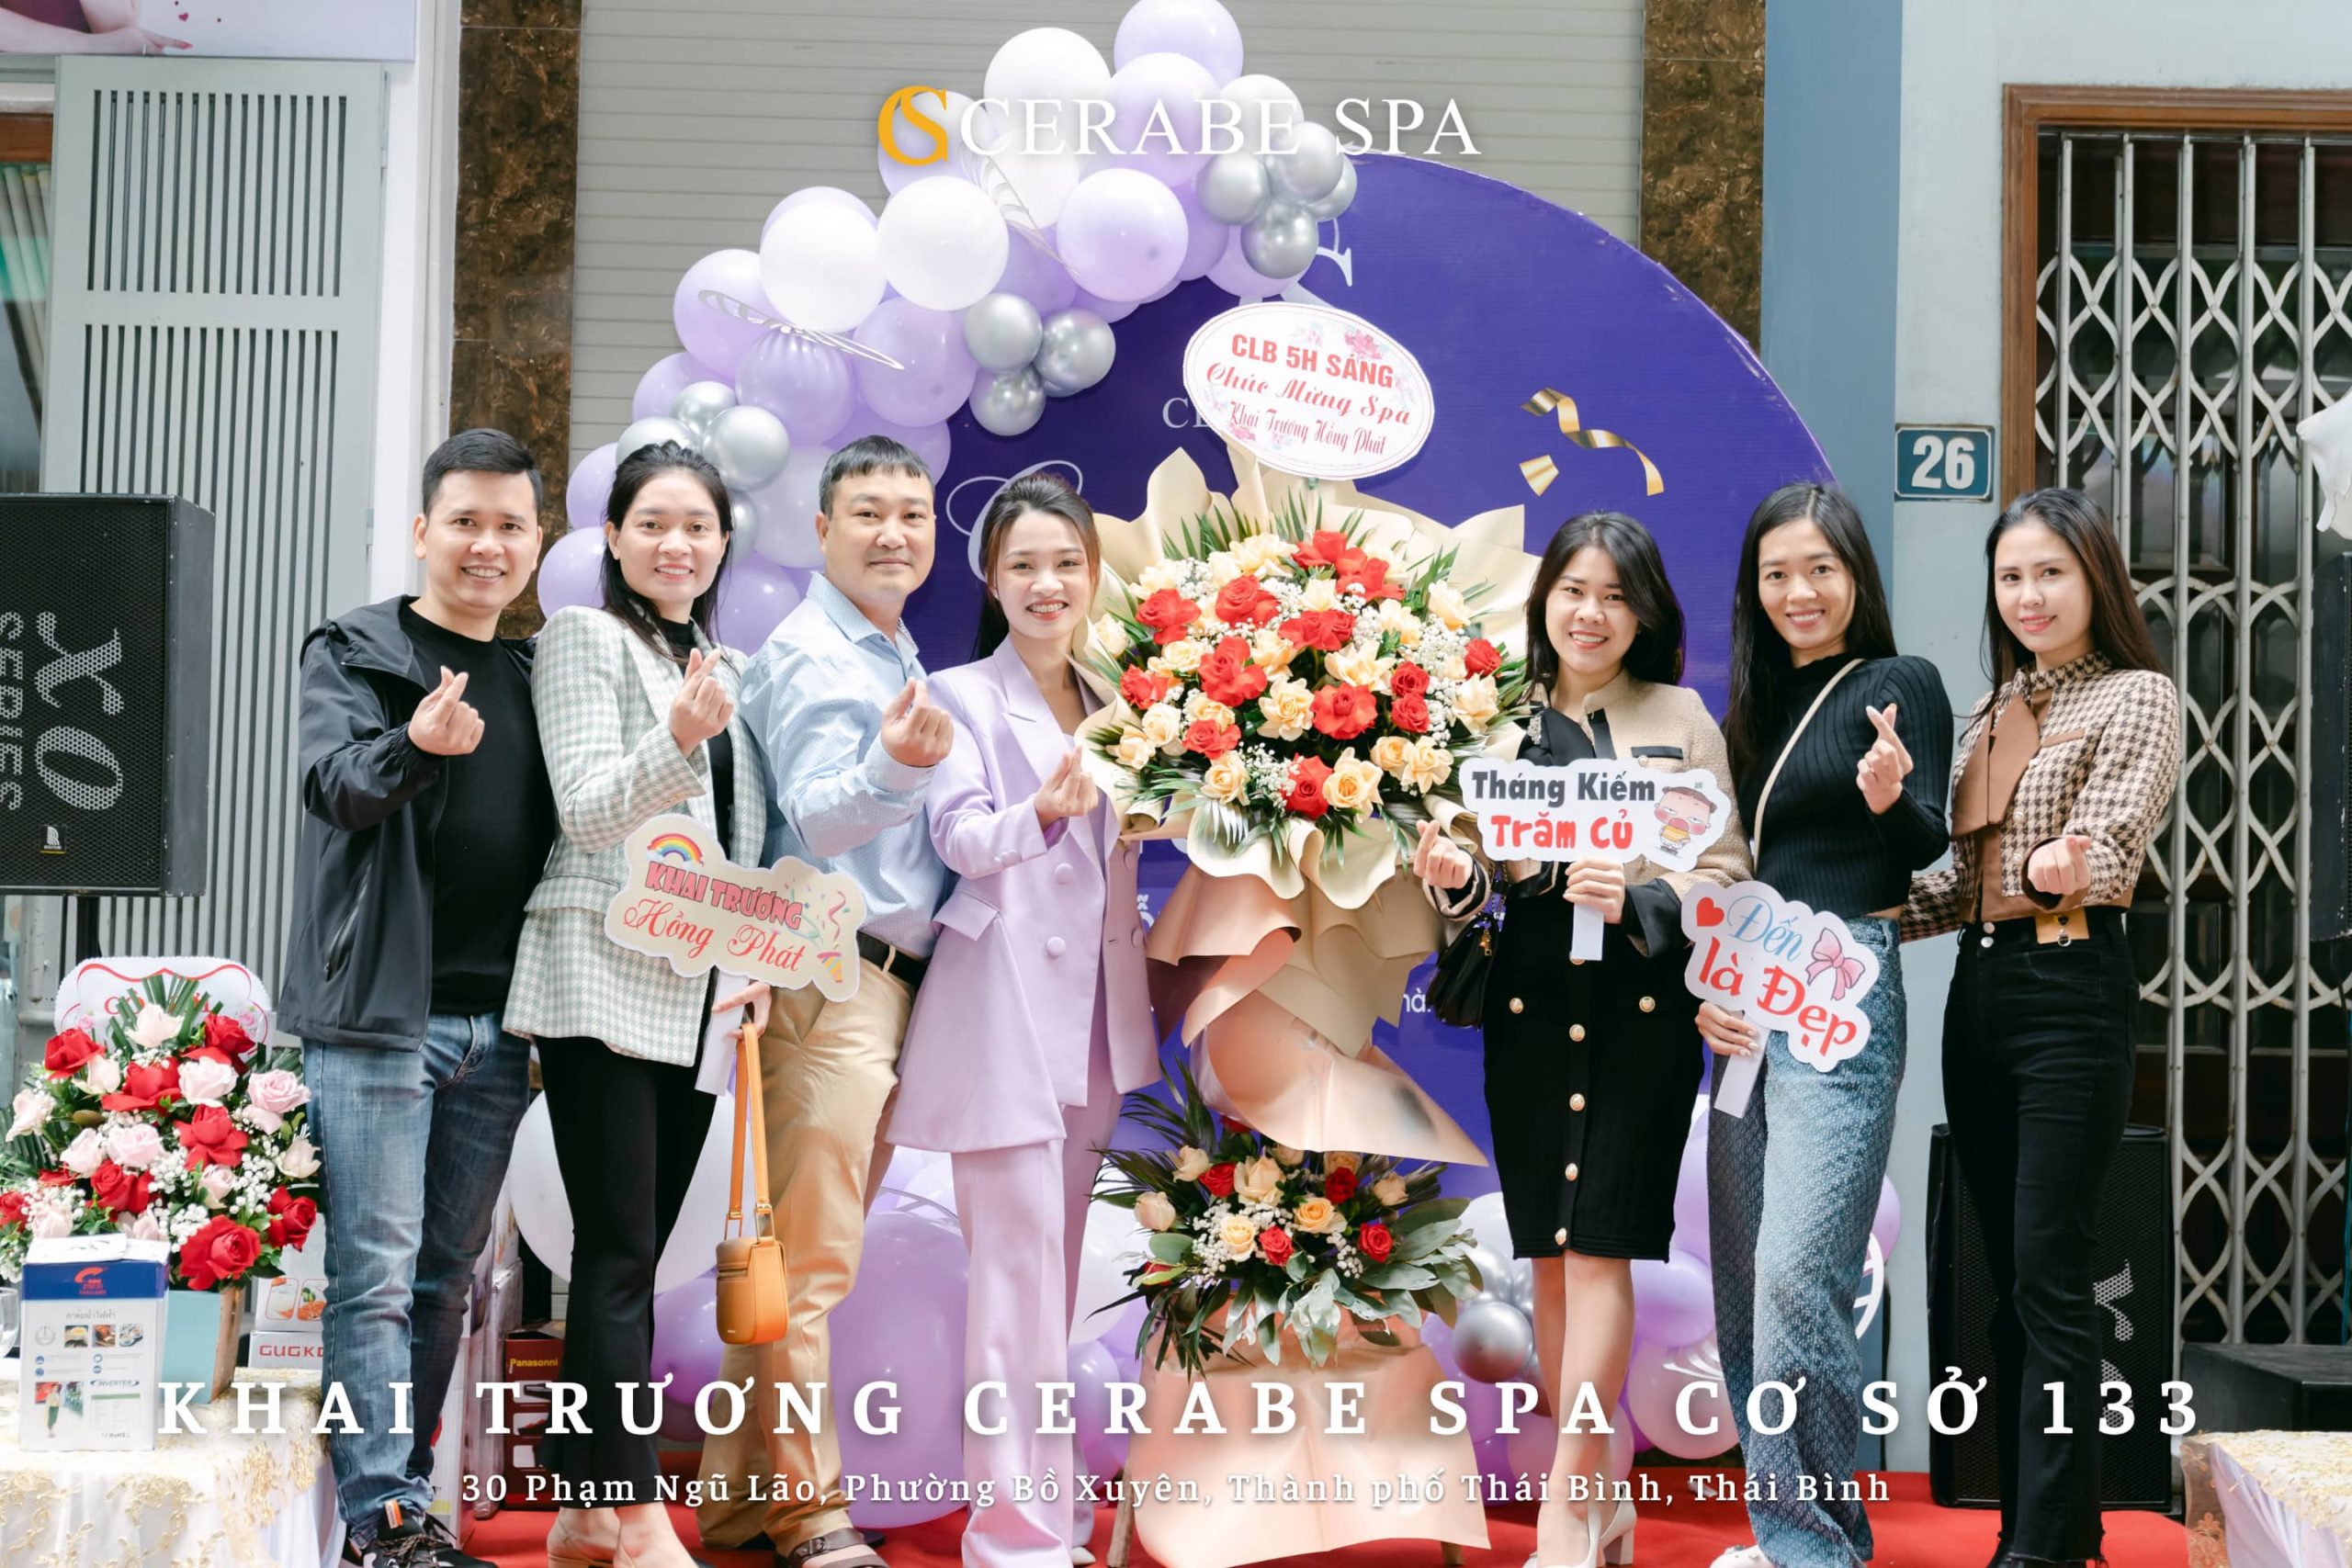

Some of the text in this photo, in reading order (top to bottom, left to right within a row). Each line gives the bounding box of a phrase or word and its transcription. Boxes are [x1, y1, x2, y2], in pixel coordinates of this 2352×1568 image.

[1231, 333, 1394, 389] CLB 5H SÁNG
[1206, 363, 1411, 425] Chúc Mừng Spa
[1229, 400, 1261, 428] Khai
[1911, 434, 1975, 490] 26
[1472, 770, 1657, 808] Tháng Kiếm
[1490, 808, 1634, 850] Trăm Củ
[645, 861, 804, 930] KHAI TRƯƠNG
[623, 897, 807, 972] Hồng Phát
[1726, 895, 1804, 963] Đến
[1698, 936, 1858, 1057] là Đẹp
